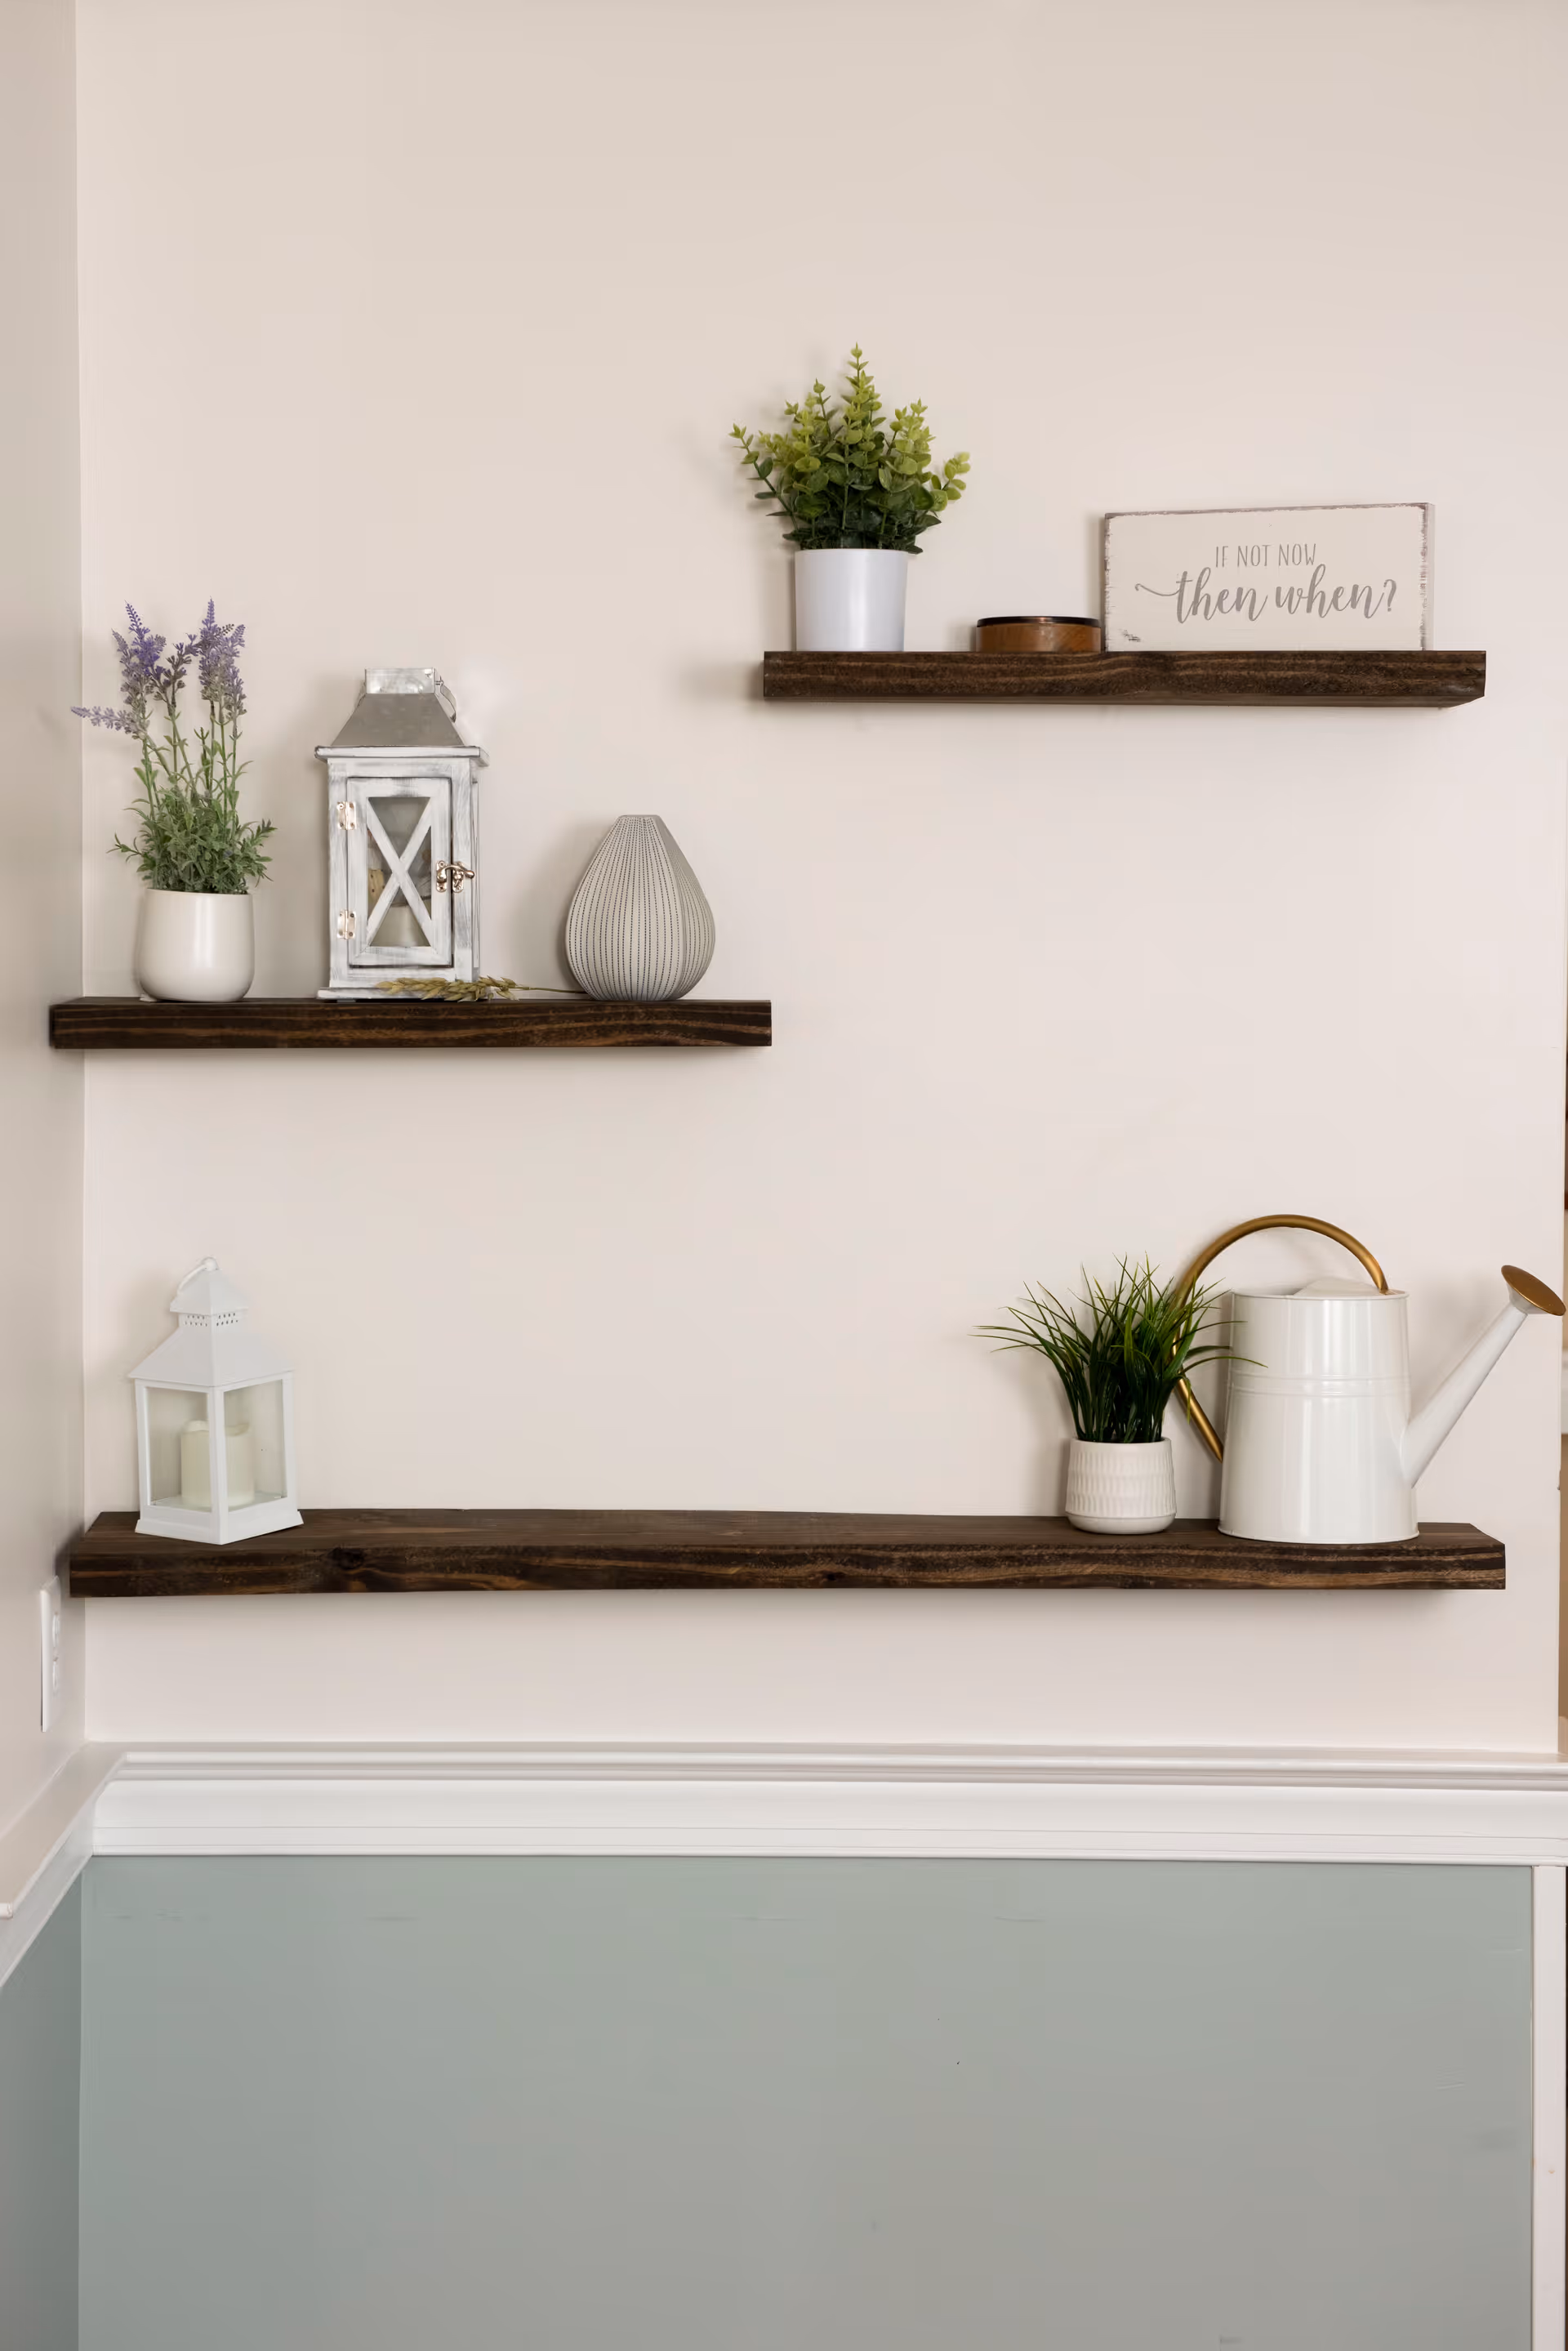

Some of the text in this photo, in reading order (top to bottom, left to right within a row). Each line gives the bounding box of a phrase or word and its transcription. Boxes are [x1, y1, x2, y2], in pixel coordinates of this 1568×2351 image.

[1214, 542, 1316, 568] IF NOT NOW
[1134, 563, 1397, 624] then when?
